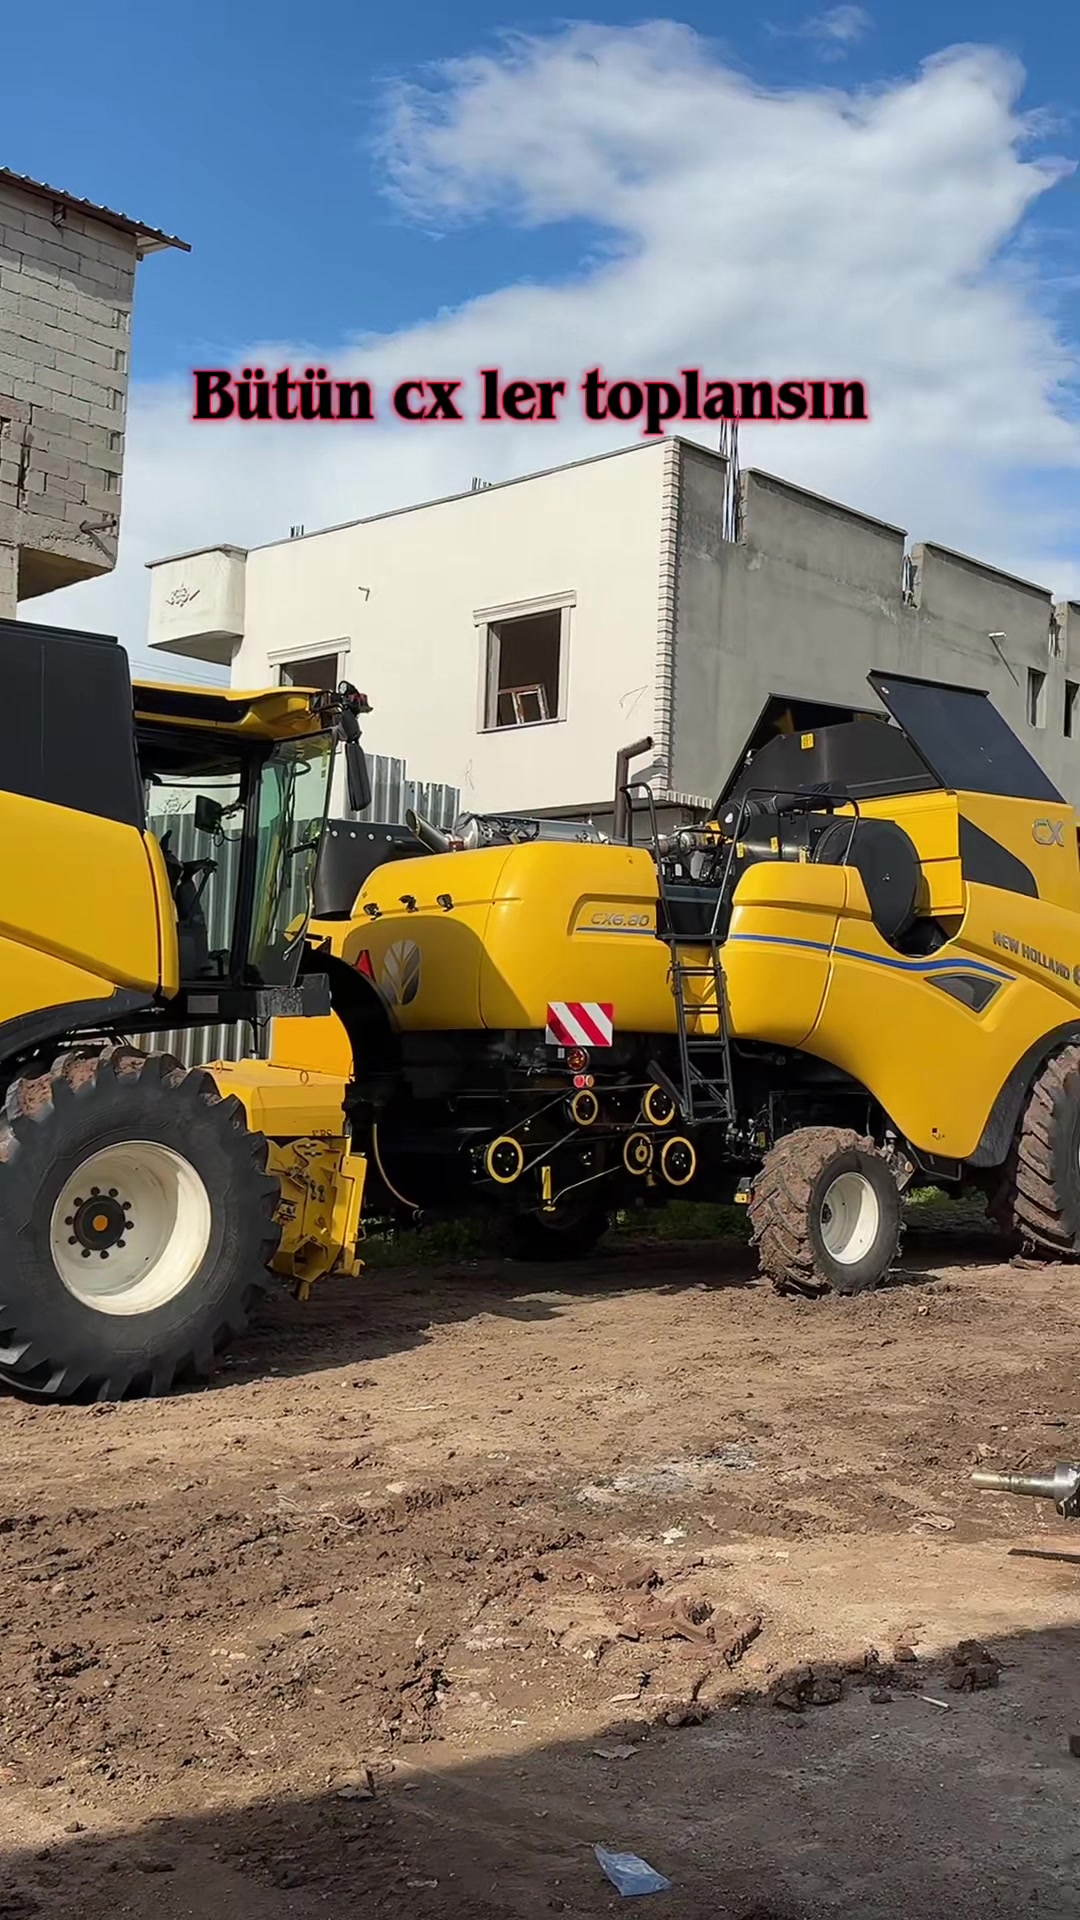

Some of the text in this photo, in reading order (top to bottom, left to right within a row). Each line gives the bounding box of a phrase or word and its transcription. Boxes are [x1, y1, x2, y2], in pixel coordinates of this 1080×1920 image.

[1032, 819, 1066, 848] CX
[590, 913, 651, 928] CX6.80
[992, 930, 1070, 981] NEW HOLLAND
